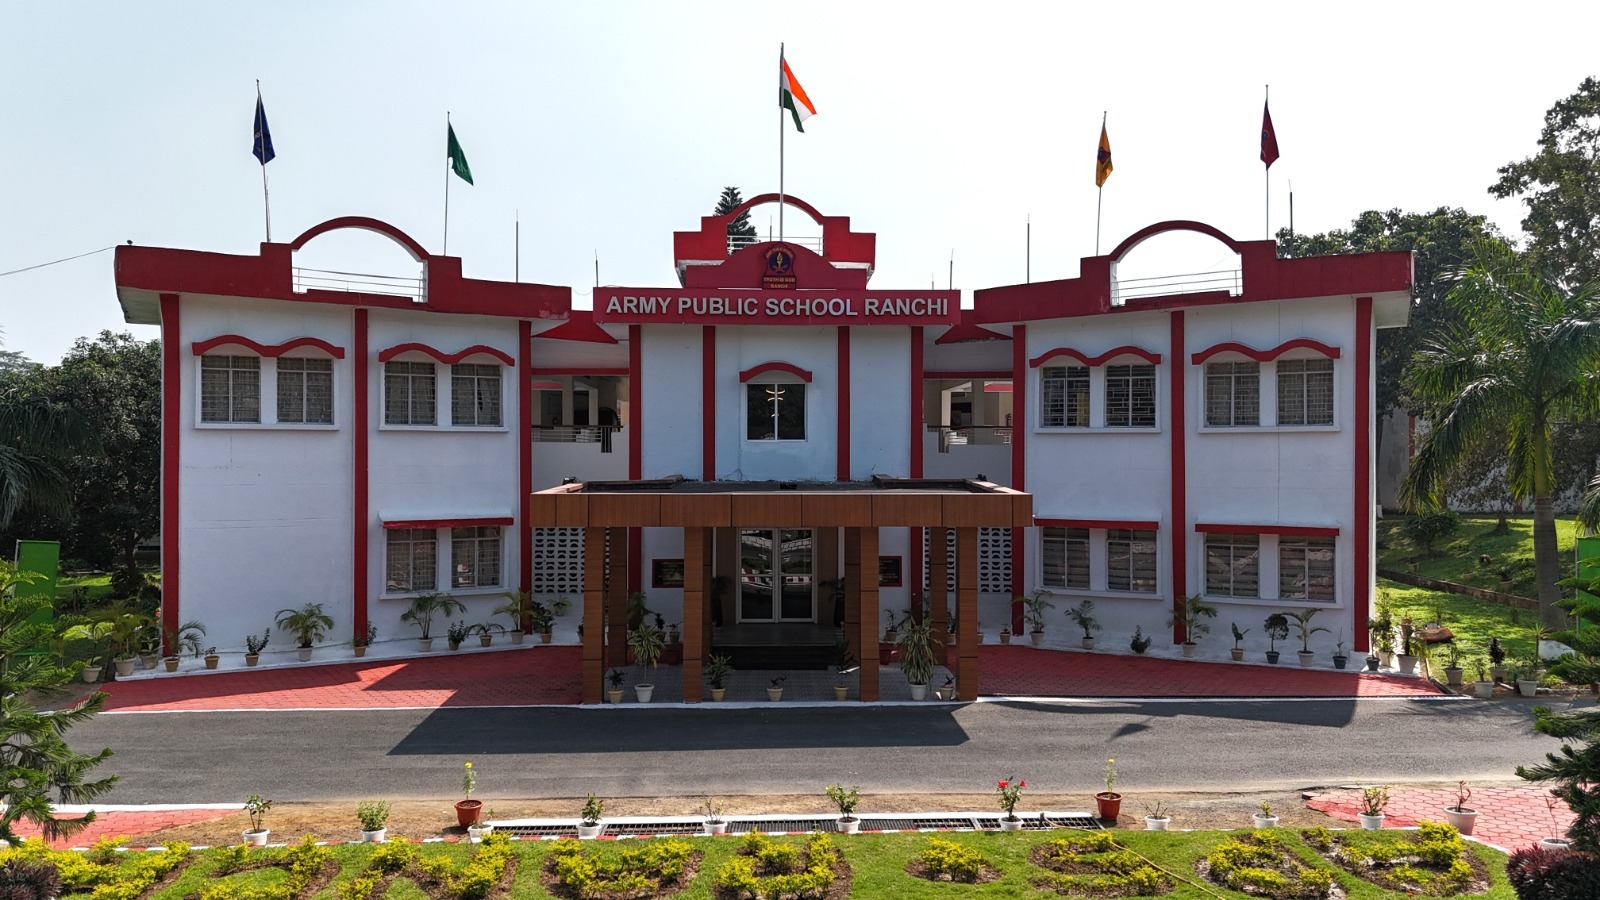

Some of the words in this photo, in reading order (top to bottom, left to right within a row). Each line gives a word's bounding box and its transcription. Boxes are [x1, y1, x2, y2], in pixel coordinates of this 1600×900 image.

[606, 296, 671, 314] ARMY
[678, 297, 758, 316] PUBLIC
[765, 298, 858, 316] SCHOOL
[864, 298, 948, 316] RANCHI
